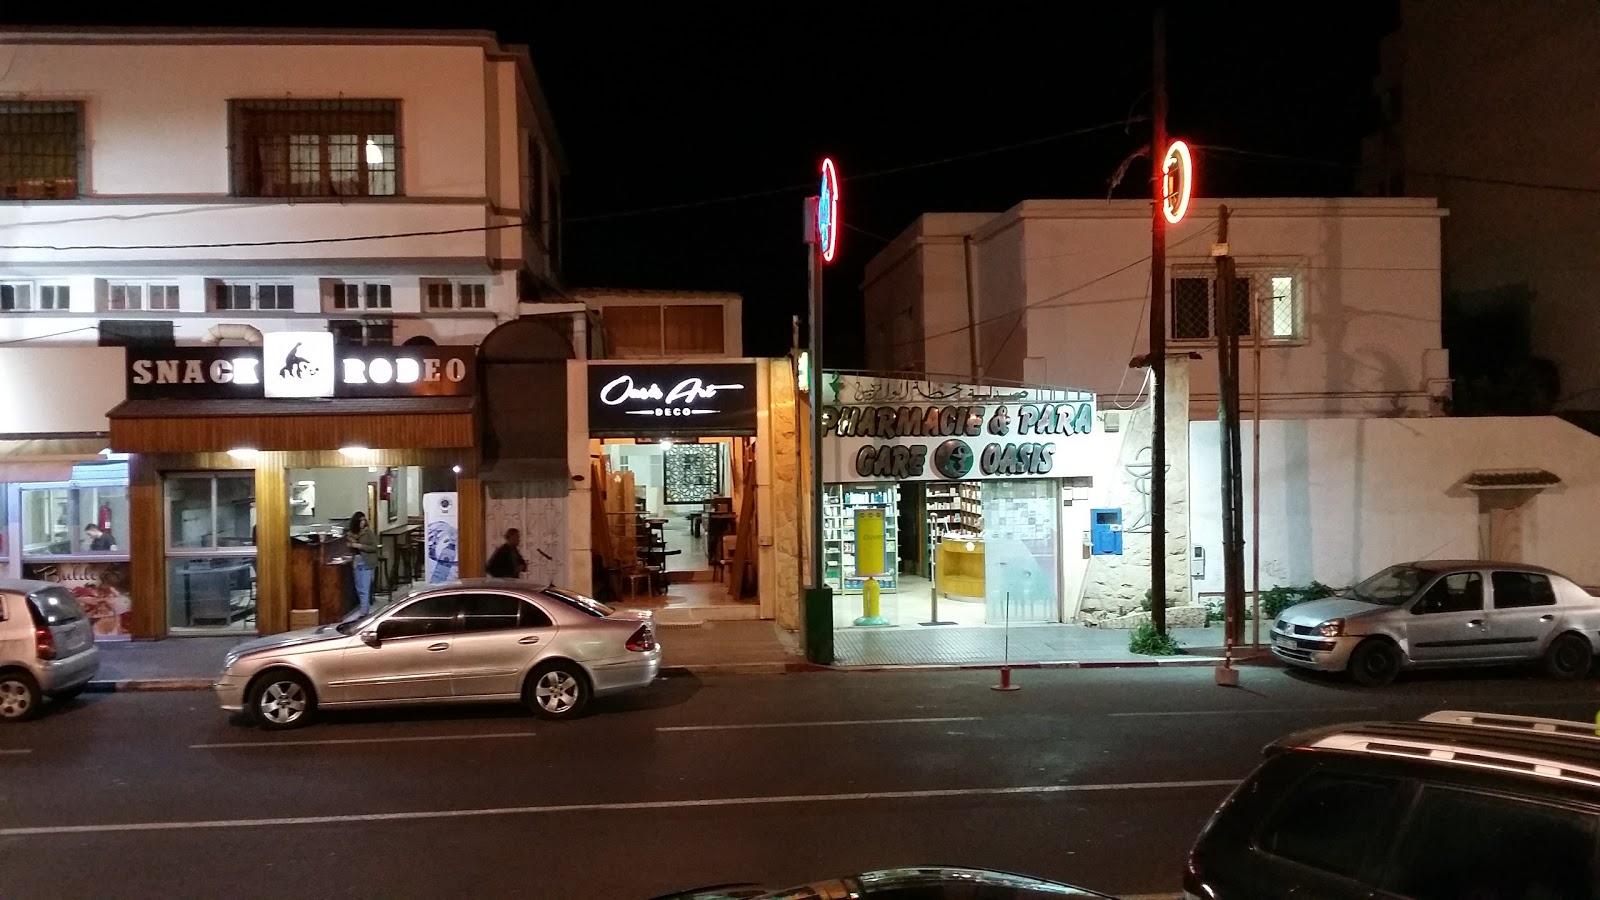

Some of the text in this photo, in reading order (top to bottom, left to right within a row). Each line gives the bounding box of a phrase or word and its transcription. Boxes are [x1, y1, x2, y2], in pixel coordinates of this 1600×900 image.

[132, 357, 466, 384] SNACK RODEO
[600, 375, 745, 405] Oasis Art
[655, 408, 691, 416] DECO
[822, 403, 1092, 439] PHARMACIE & PARA
[856, 442, 1056, 479] GARE OASIS
